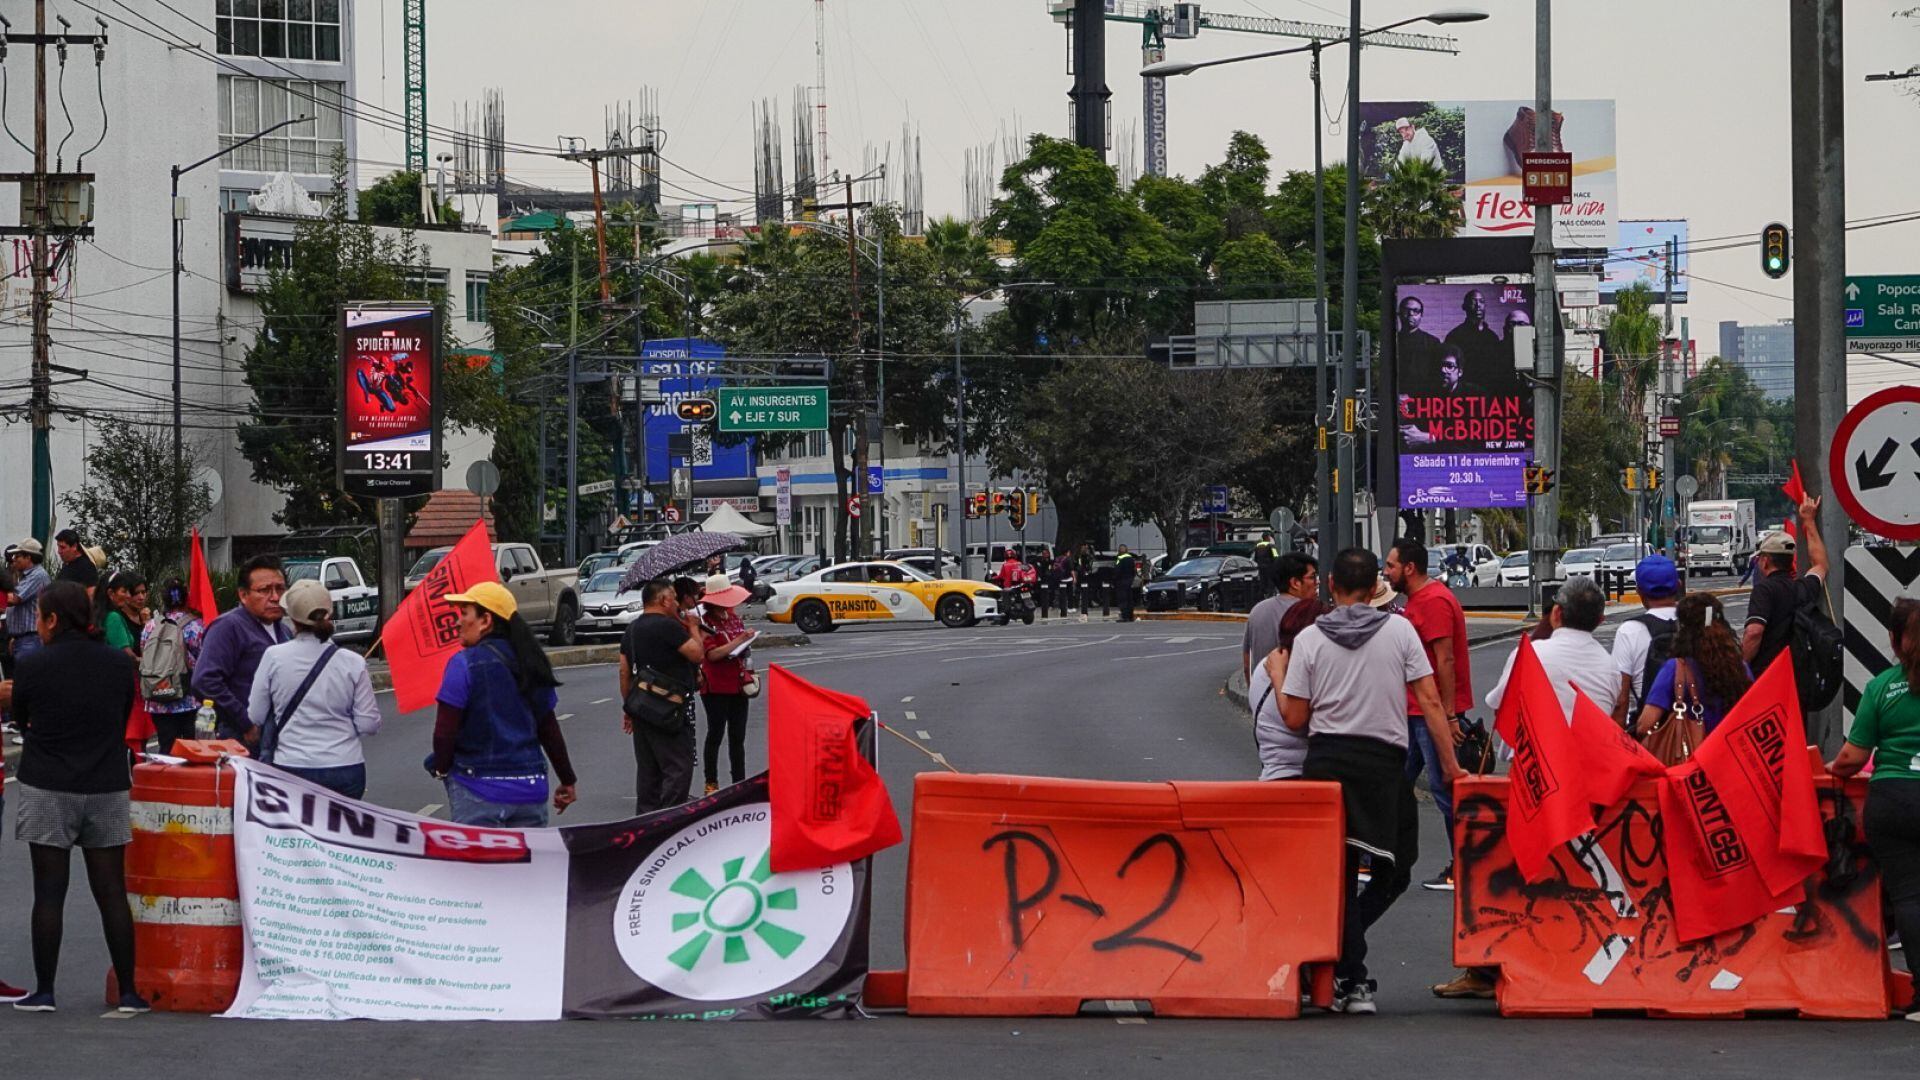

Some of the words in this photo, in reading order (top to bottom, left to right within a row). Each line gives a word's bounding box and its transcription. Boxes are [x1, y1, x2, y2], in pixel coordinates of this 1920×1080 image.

[1527, 173, 1567, 185] 911
[1877, 284, 1920, 298] Popoc
[1877, 302, 1905, 315] Sala
[1894, 318, 1920, 330] Can
[414, 337, 421, 356] 2
[1849, 340, 1902, 352] Mayorazgo
[730, 396, 747, 407] AV.
[749, 395, 817, 407] INSURGENTES
[1400, 395, 1520, 419] CHRISTIAN
[745, 411, 766, 422] EJE
[768, 411, 775, 422] 7
[777, 411, 801, 422] SUR
[1486, 440, 1503, 449] NEW
[1505, 440, 1526, 449] JAWN
[364, 453, 412, 470] 13:41
[1413, 455, 1446, 468] Sábado
[1448, 456, 1458, 467] 11
[1460, 455, 1472, 467] de
[1473, 455, 1520, 467] noviembre
[1450, 472, 1474, 484] 20:30
[1408, 494, 1458, 505] CANTORAL
[266, 852, 327, 868] Recuperación
[327, 850, 398, 872] DEMANDAS:
[628, 888, 646, 937] FRENTE
[639, 836, 696, 887] SINDICAL
[696, 811, 766, 838] UNITARIO
[262, 867, 281, 880] 20%
[282, 872, 293, 883] de
[295, 877, 335, 886] aumento
[368, 890, 384, 900] por
[385, 892, 426, 905] Revisión
[982, 830, 1204, 962] P-2
[253, 897, 286, 910] Andrés
[288, 903, 321, 917] Manuel
[322, 907, 349, 920] López
[351, 908, 389, 924] Obrador
[284, 891, 296, 901] de
[297, 894, 365, 908] fortalecimiento
[376, 905, 406, 919] salario
[407, 913, 426, 923] que
[427, 914, 437, 922] el
[437, 915, 487, 926] presidente
[259, 917, 322, 936] Cumplimiento
[323, 929, 331, 937] a
[332, 928, 341, 938] la
[342, 930, 394, 942] disposición
[396, 936, 452, 951] presidencial
[453, 943, 466, 952] de
[467, 944, 500, 955] igualar
[264, 942, 298, 955] mínimo
[299, 949, 312, 957] de
[313, 949, 321, 959] $
[366, 955, 394, 966] pesos
[267, 930, 303, 945] salarios
[305, 938, 317, 947] de
[319, 938, 333, 949] los
[335, 939, 392, 953] trabajadores
[394, 944, 406, 953] de
[407, 946, 416, 956] la
[417, 949, 465, 962] educación
[475, 956, 503, 964] ganar
[260, 955, 286, 967] Revis
[333, 968, 377, 982] Unificada
[378, 974, 391, 983] en
[392, 974, 402, 984] el
[403, 976, 423, 986] mes
[424, 976, 437, 986] de
[438, 977, 489, 990] Noviembre
[489, 982, 512, 993] para
